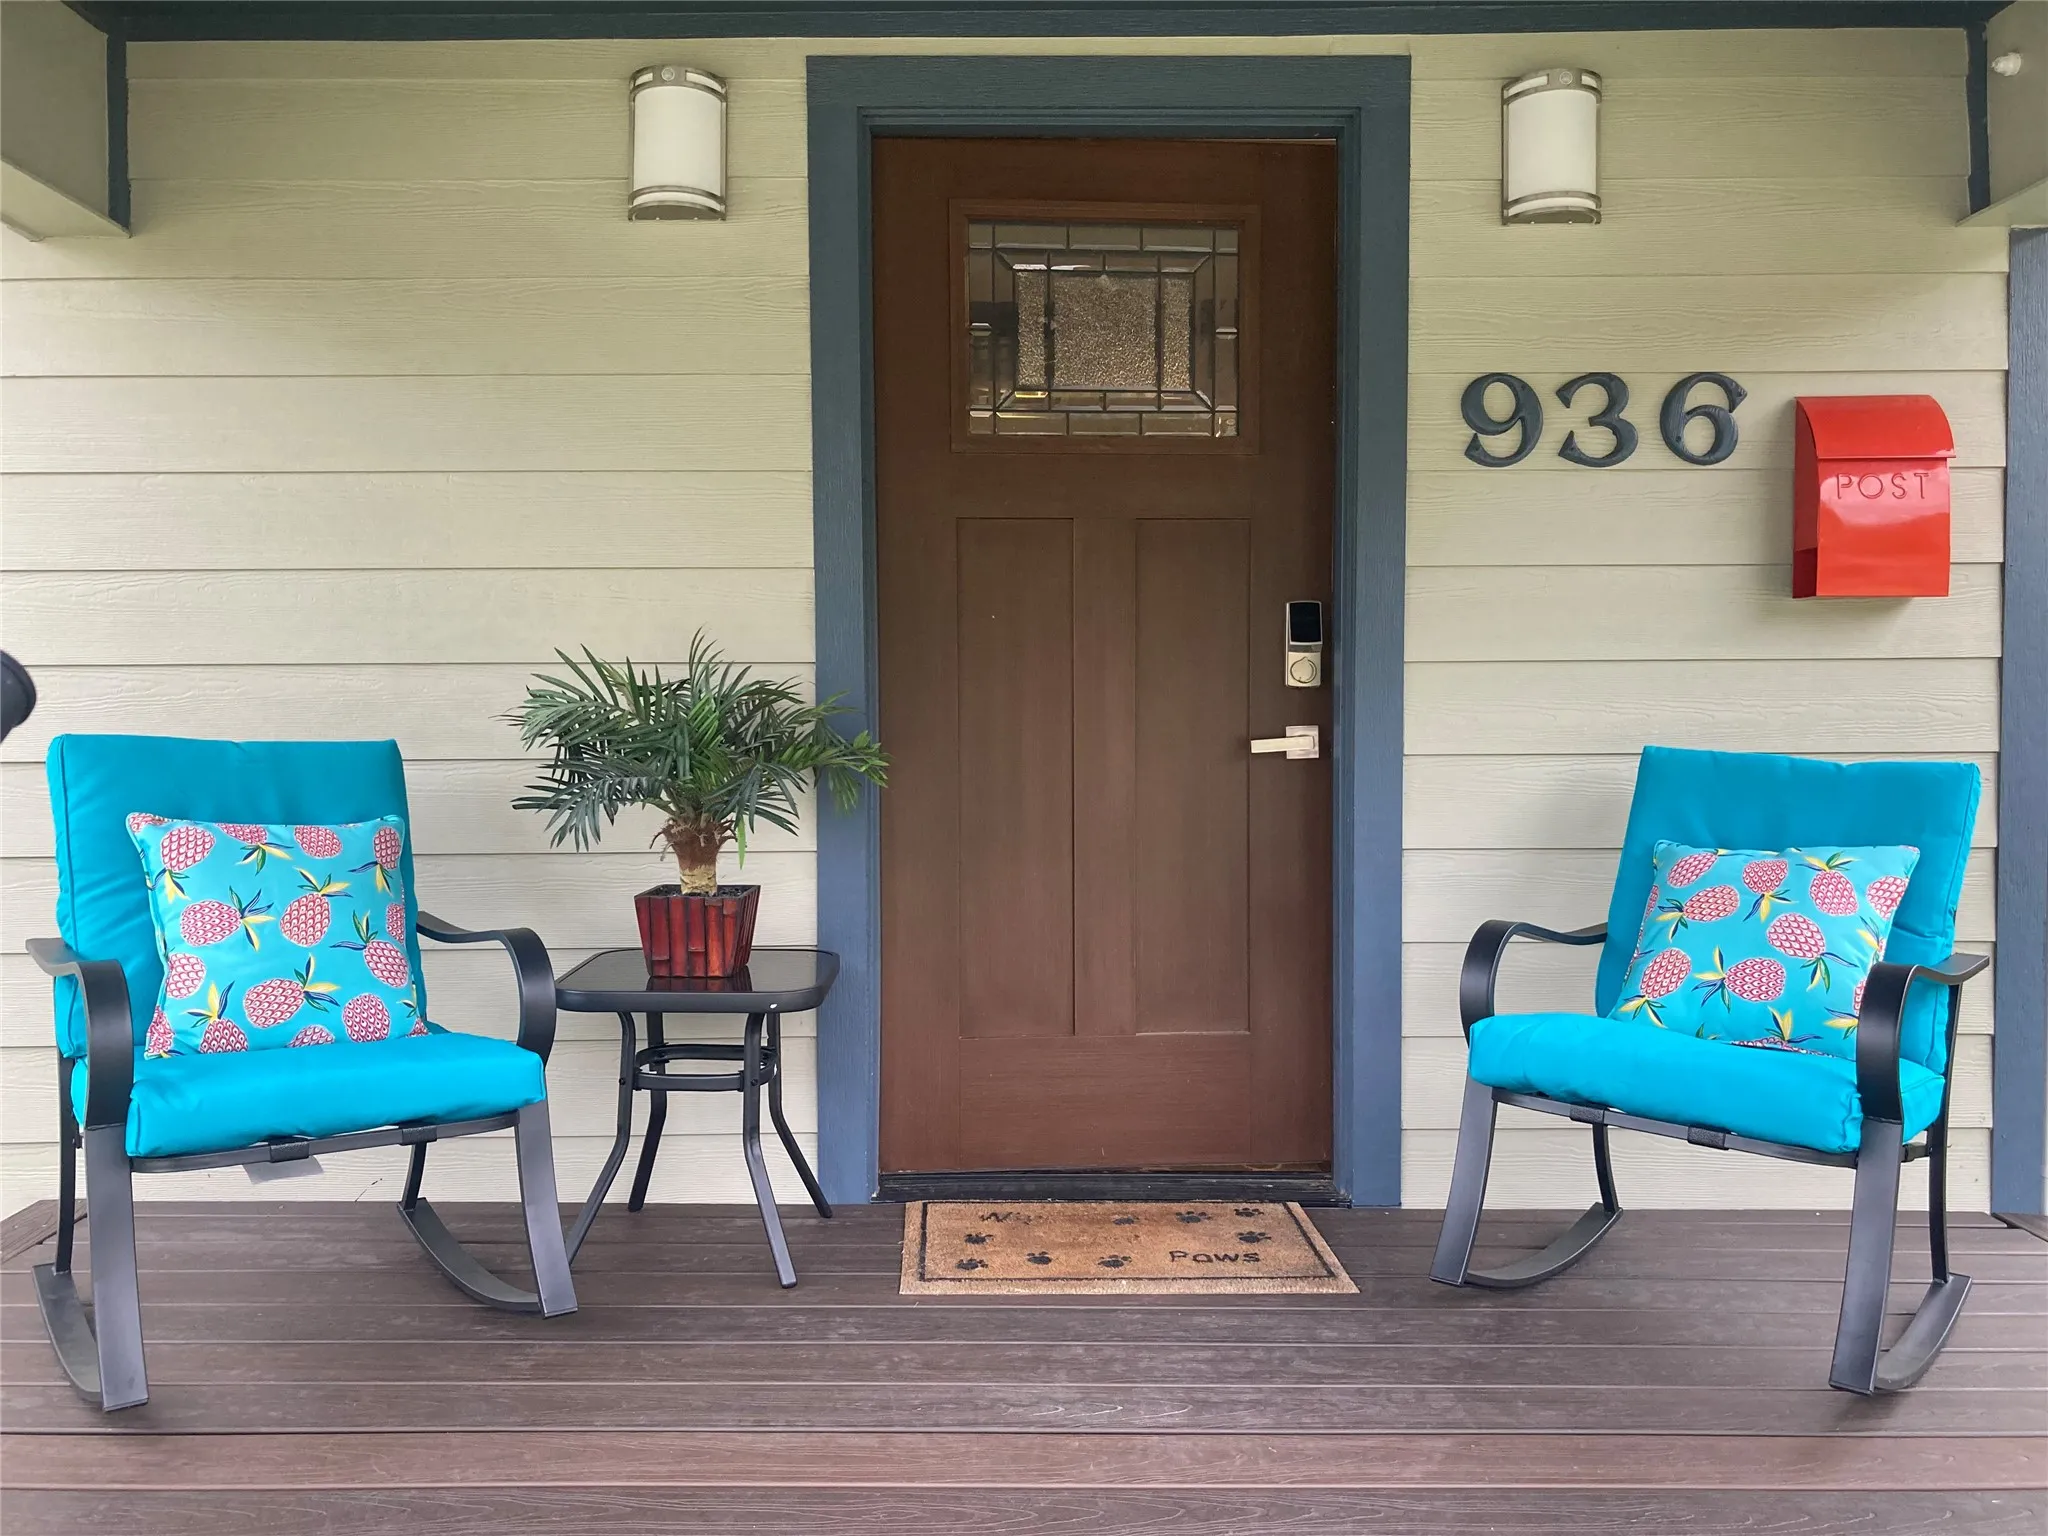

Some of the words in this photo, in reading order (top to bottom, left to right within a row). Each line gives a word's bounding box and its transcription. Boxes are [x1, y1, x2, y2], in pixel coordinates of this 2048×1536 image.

[1460, 372, 1748, 468] 936
[1836, 473, 1930, 500] POST
[1168, 1250, 1261, 1263] Paws
